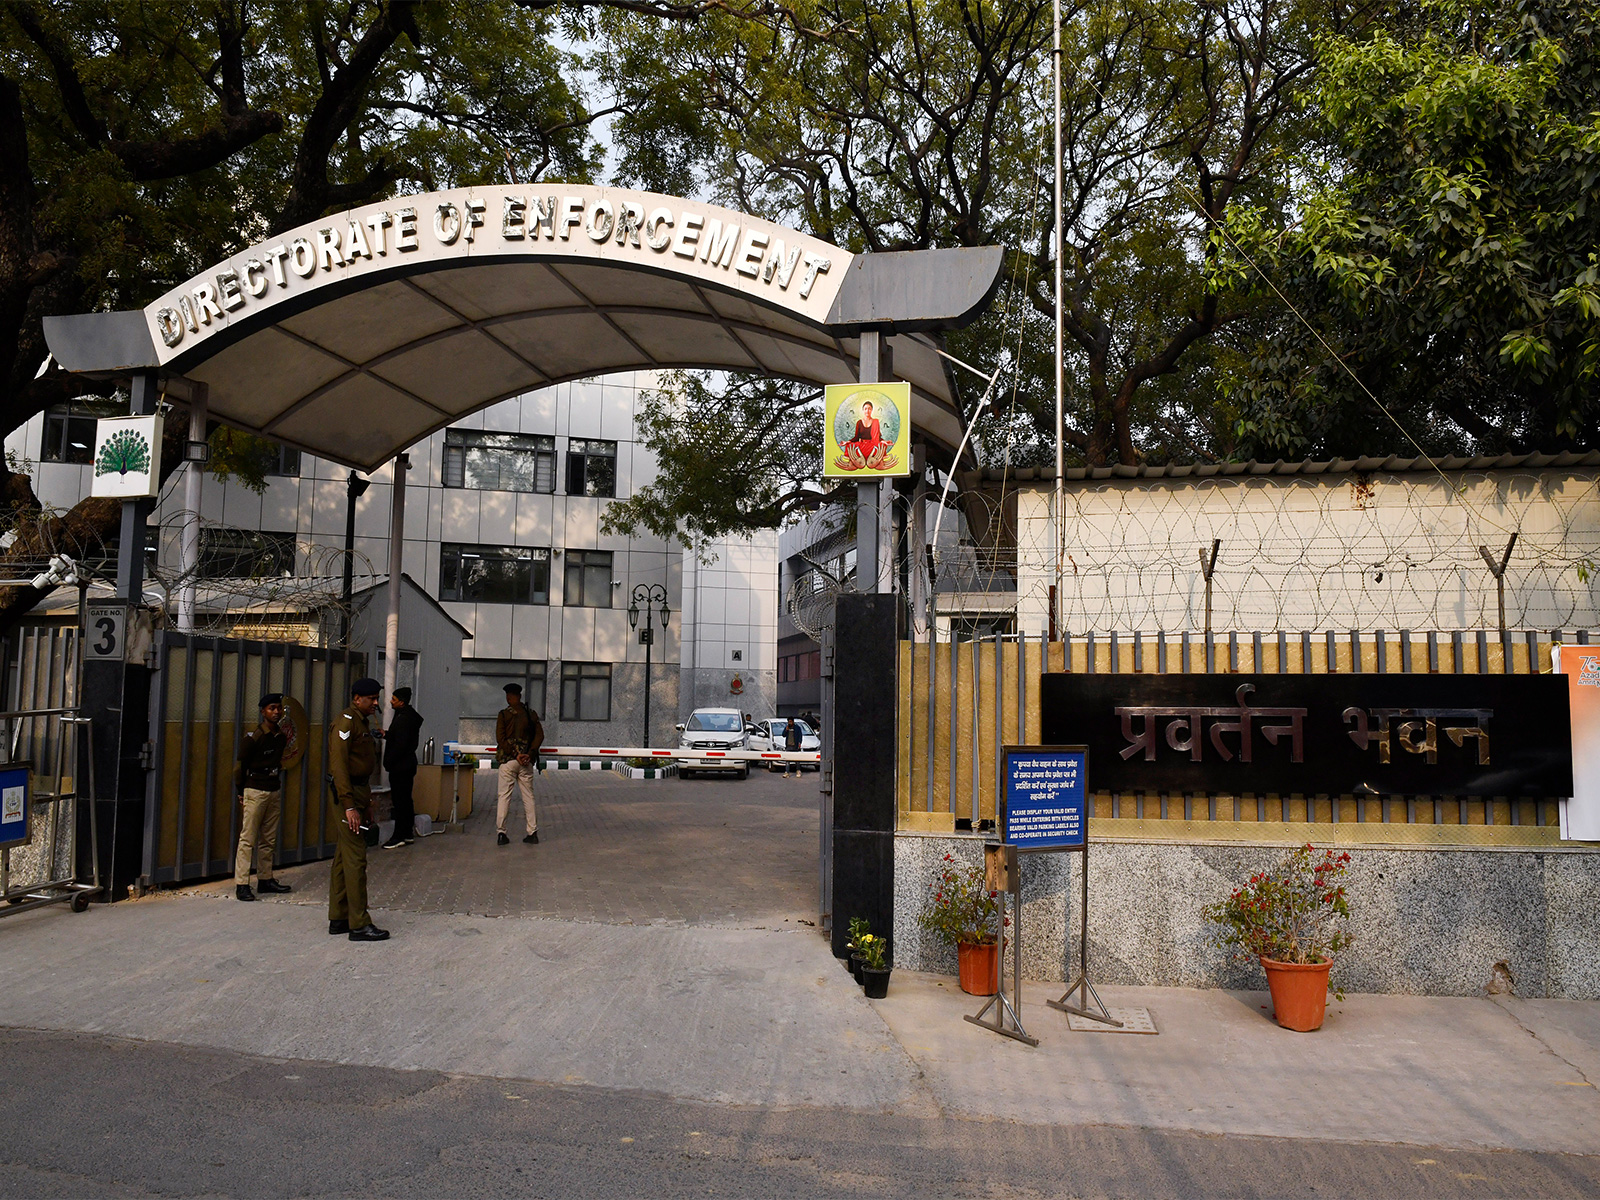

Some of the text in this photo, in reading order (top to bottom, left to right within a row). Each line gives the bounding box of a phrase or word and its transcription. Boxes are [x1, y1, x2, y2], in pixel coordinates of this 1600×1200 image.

[155, 195, 832, 348] DIRECTORATE OF ENFORCEMENT
[93, 617, 116, 655] 3
[733, 651, 740, 659] A
[1114, 683, 1494, 766] प्रवर्तन भवन
